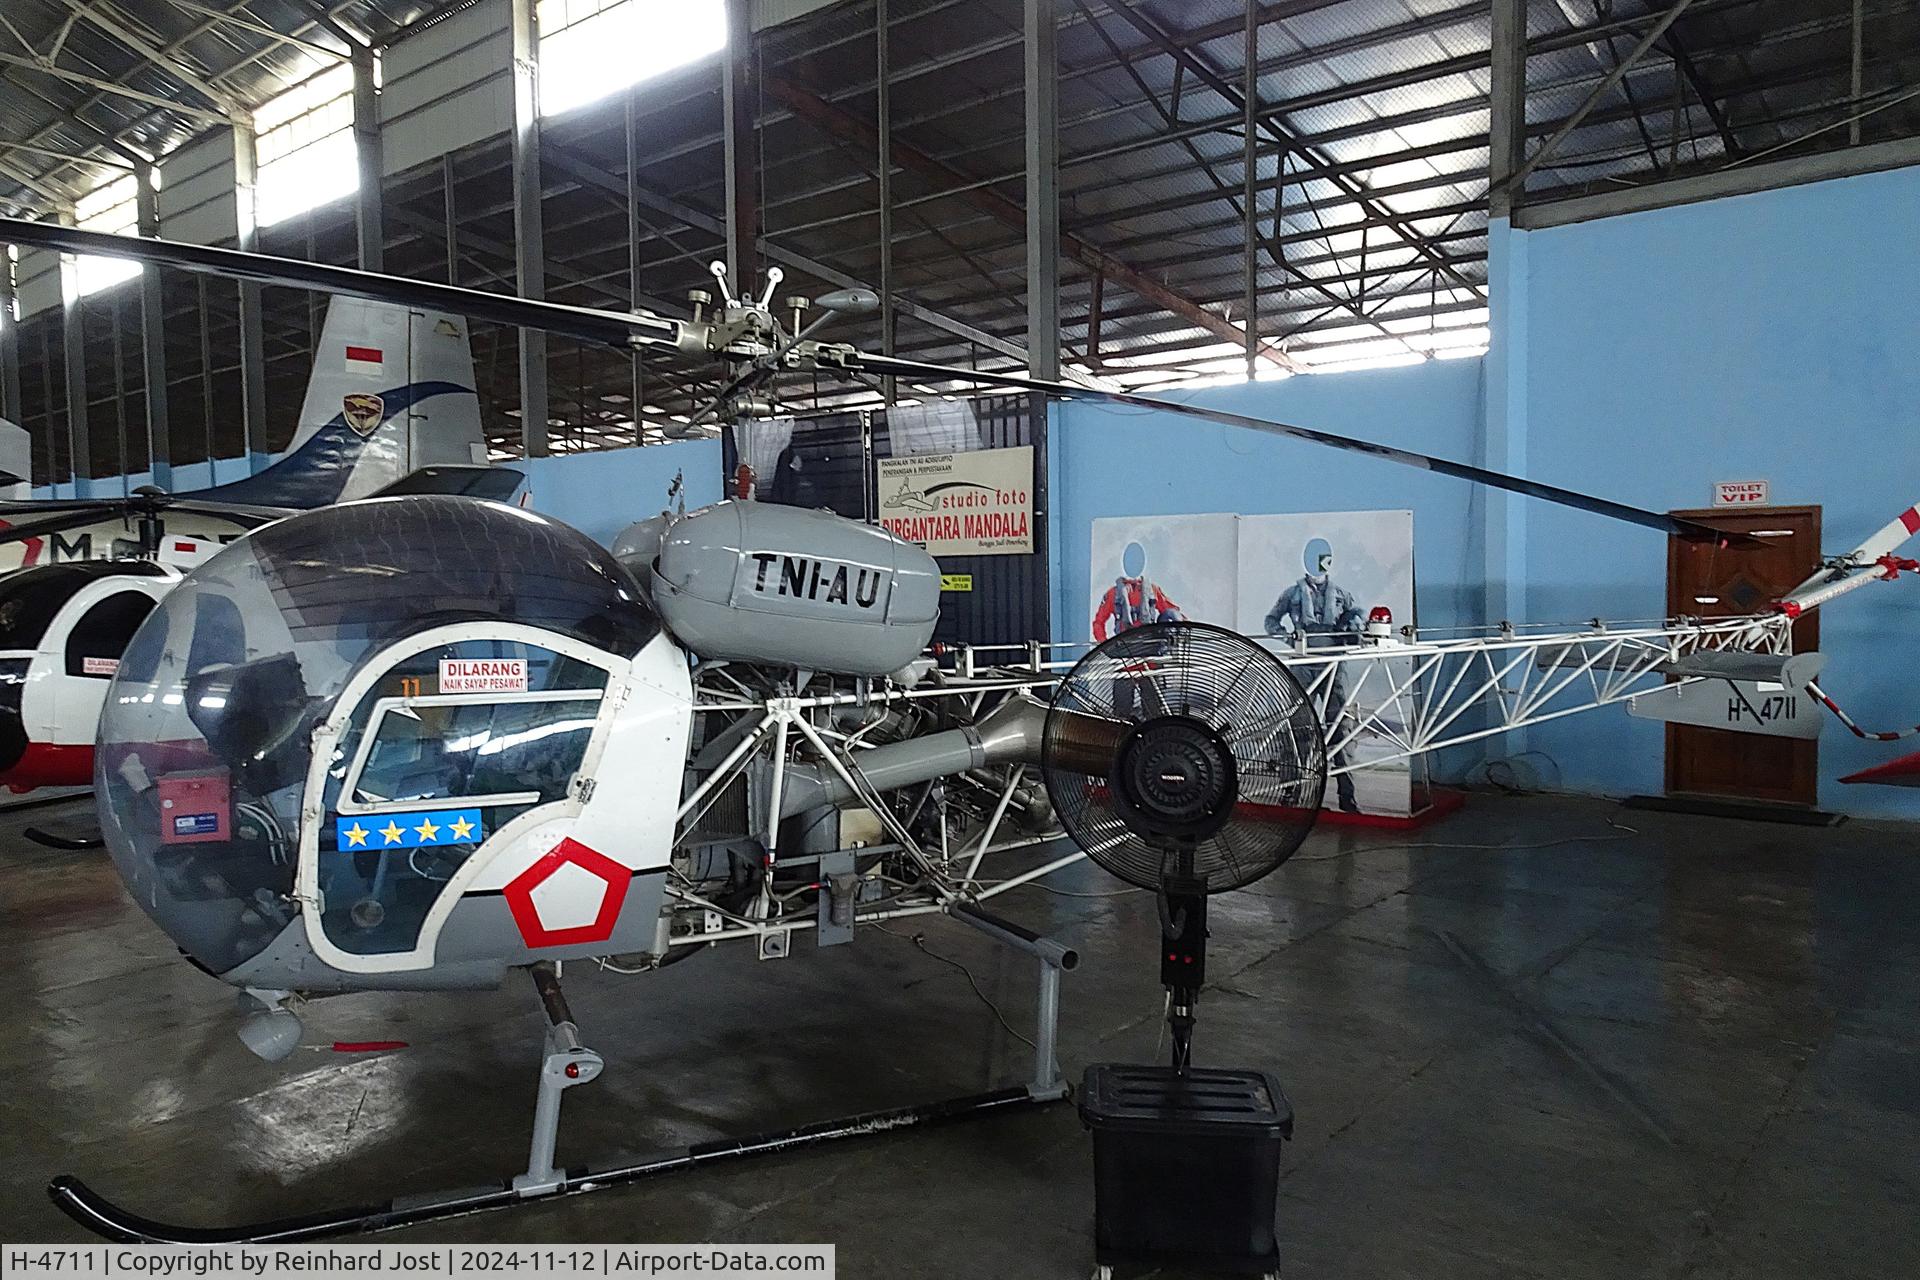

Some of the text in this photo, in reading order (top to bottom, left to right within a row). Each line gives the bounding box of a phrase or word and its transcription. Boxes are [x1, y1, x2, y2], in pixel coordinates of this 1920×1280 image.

[942, 489, 1026, 509] studio foto
[1722, 493, 1762, 502] VIP
[964, 512, 1028, 539] MANDALA
[752, 553, 880, 609] TNI-AU
[448, 663, 520, 676] DILARANG
[444, 678, 524, 690] NAIK SAYAP PESAWAT
